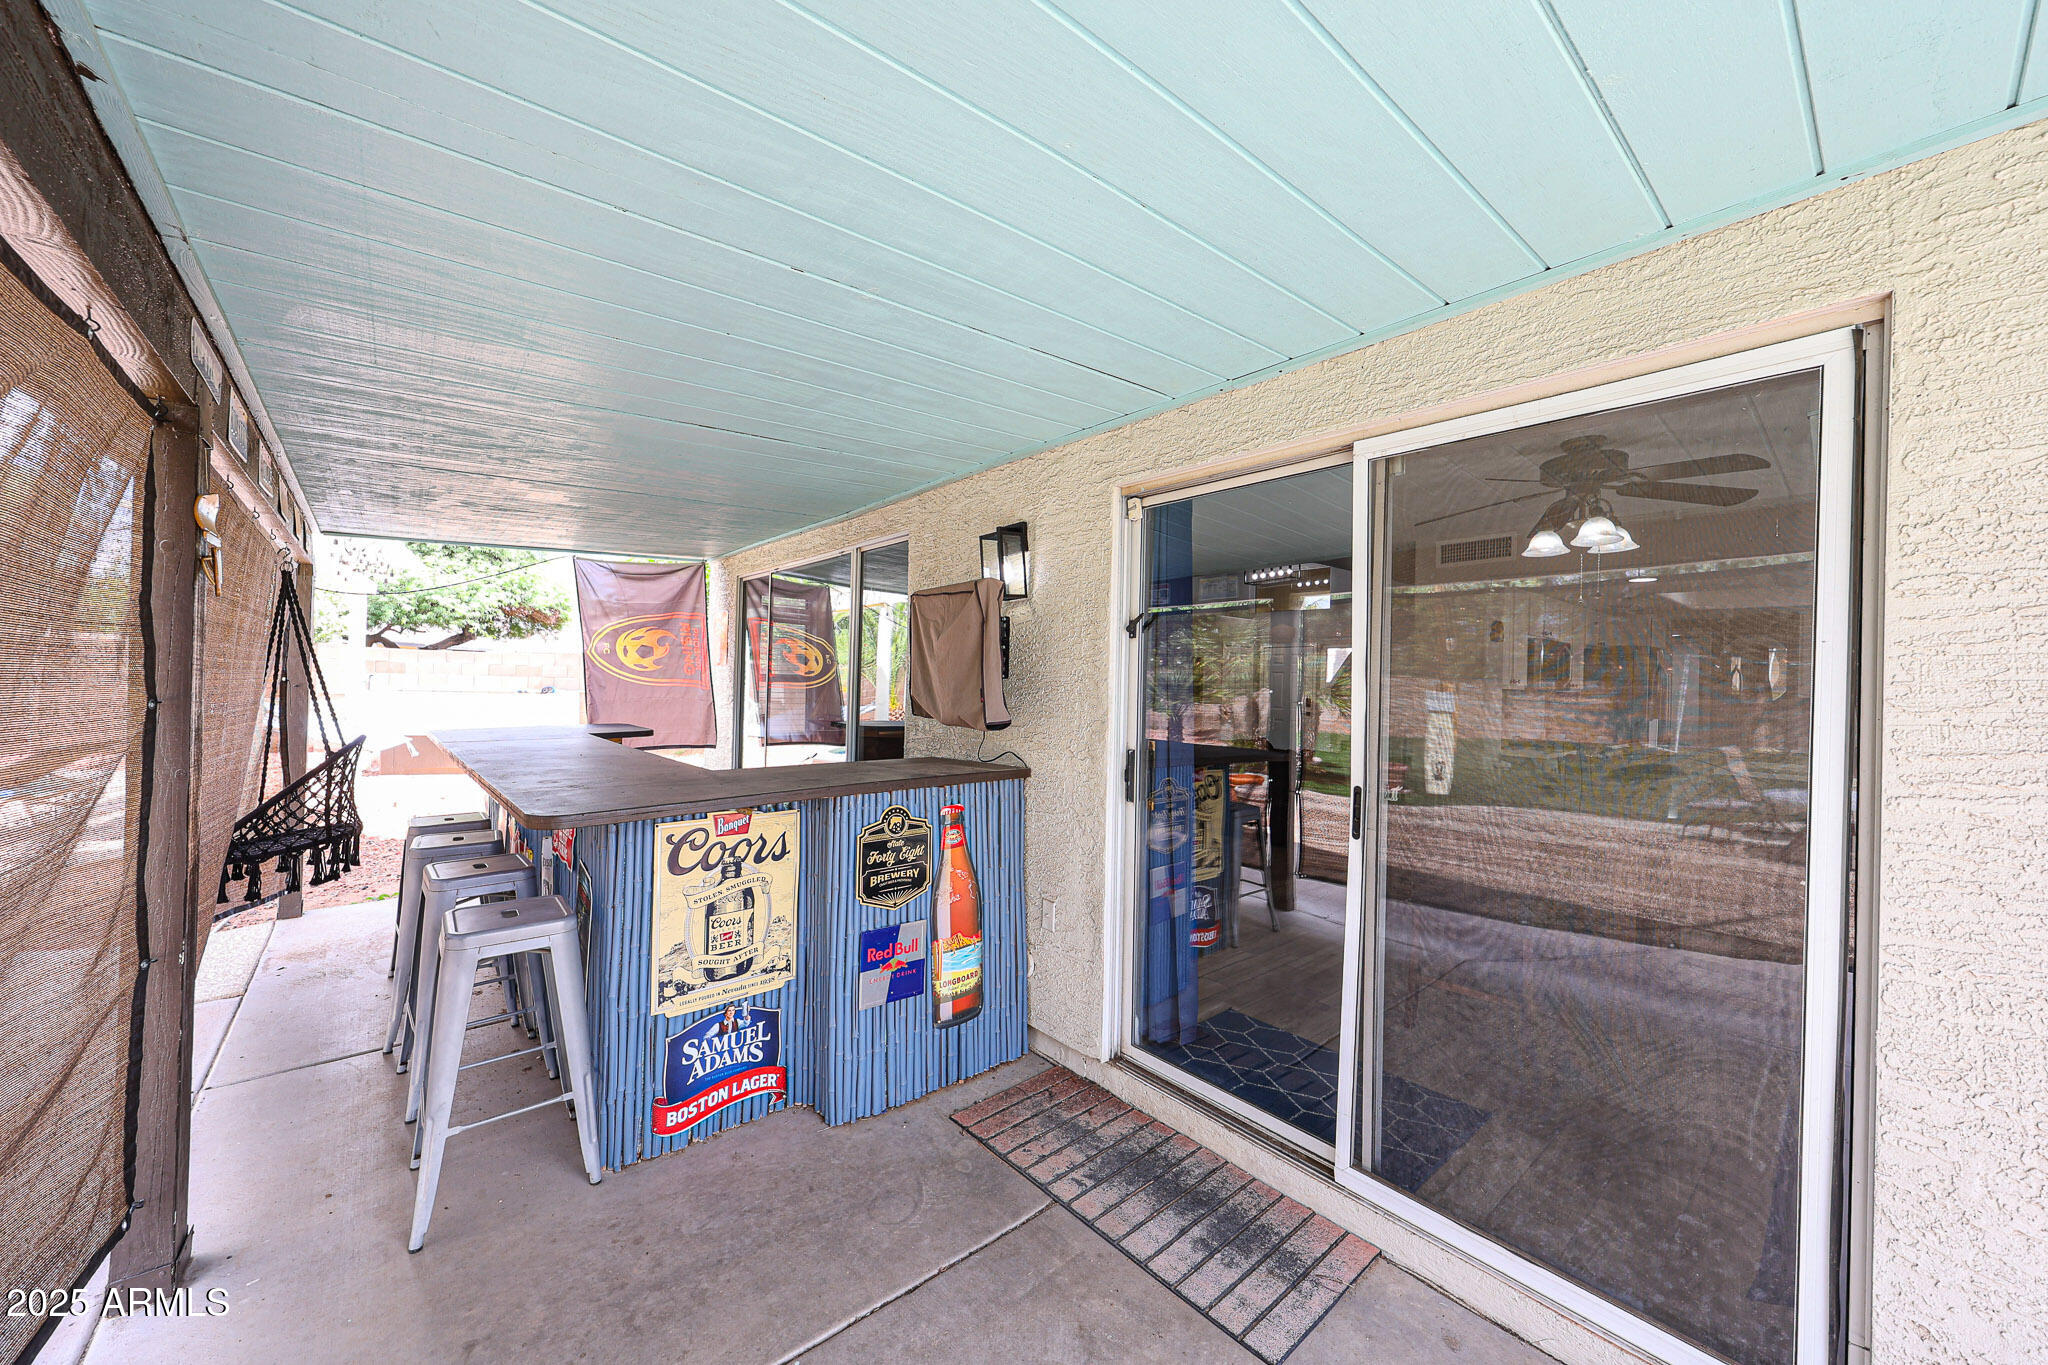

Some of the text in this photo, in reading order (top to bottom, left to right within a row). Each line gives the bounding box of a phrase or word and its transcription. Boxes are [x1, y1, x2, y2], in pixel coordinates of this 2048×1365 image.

[603, 642, 611, 655] FC
[680, 622, 696, 676] RISING
[717, 815, 750, 836] Banquet
[666, 827, 791, 876] Coors
[886, 839, 905, 849] State
[866, 844, 925, 867] Forty Eight
[870, 867, 920, 888] BREWERY
[693, 889, 723, 905] STOLEN
[725, 876, 767, 893] SMUGGLED
[710, 916, 742, 930] Coors
[697, 946, 759, 966] SOUGHT AFTER
[710, 939, 742, 952] BEER
[867, 937, 919, 963] Red Bull
[896, 969, 917, 979] DRINK
[940, 970, 979, 988] LONGBOARD
[721, 984, 746, 996] Nevada
[681, 1020, 771, 1066] SAMUEL
[686, 1041, 764, 1086] ADAMS
[665, 1073, 778, 1128] BOSTON LAGER
